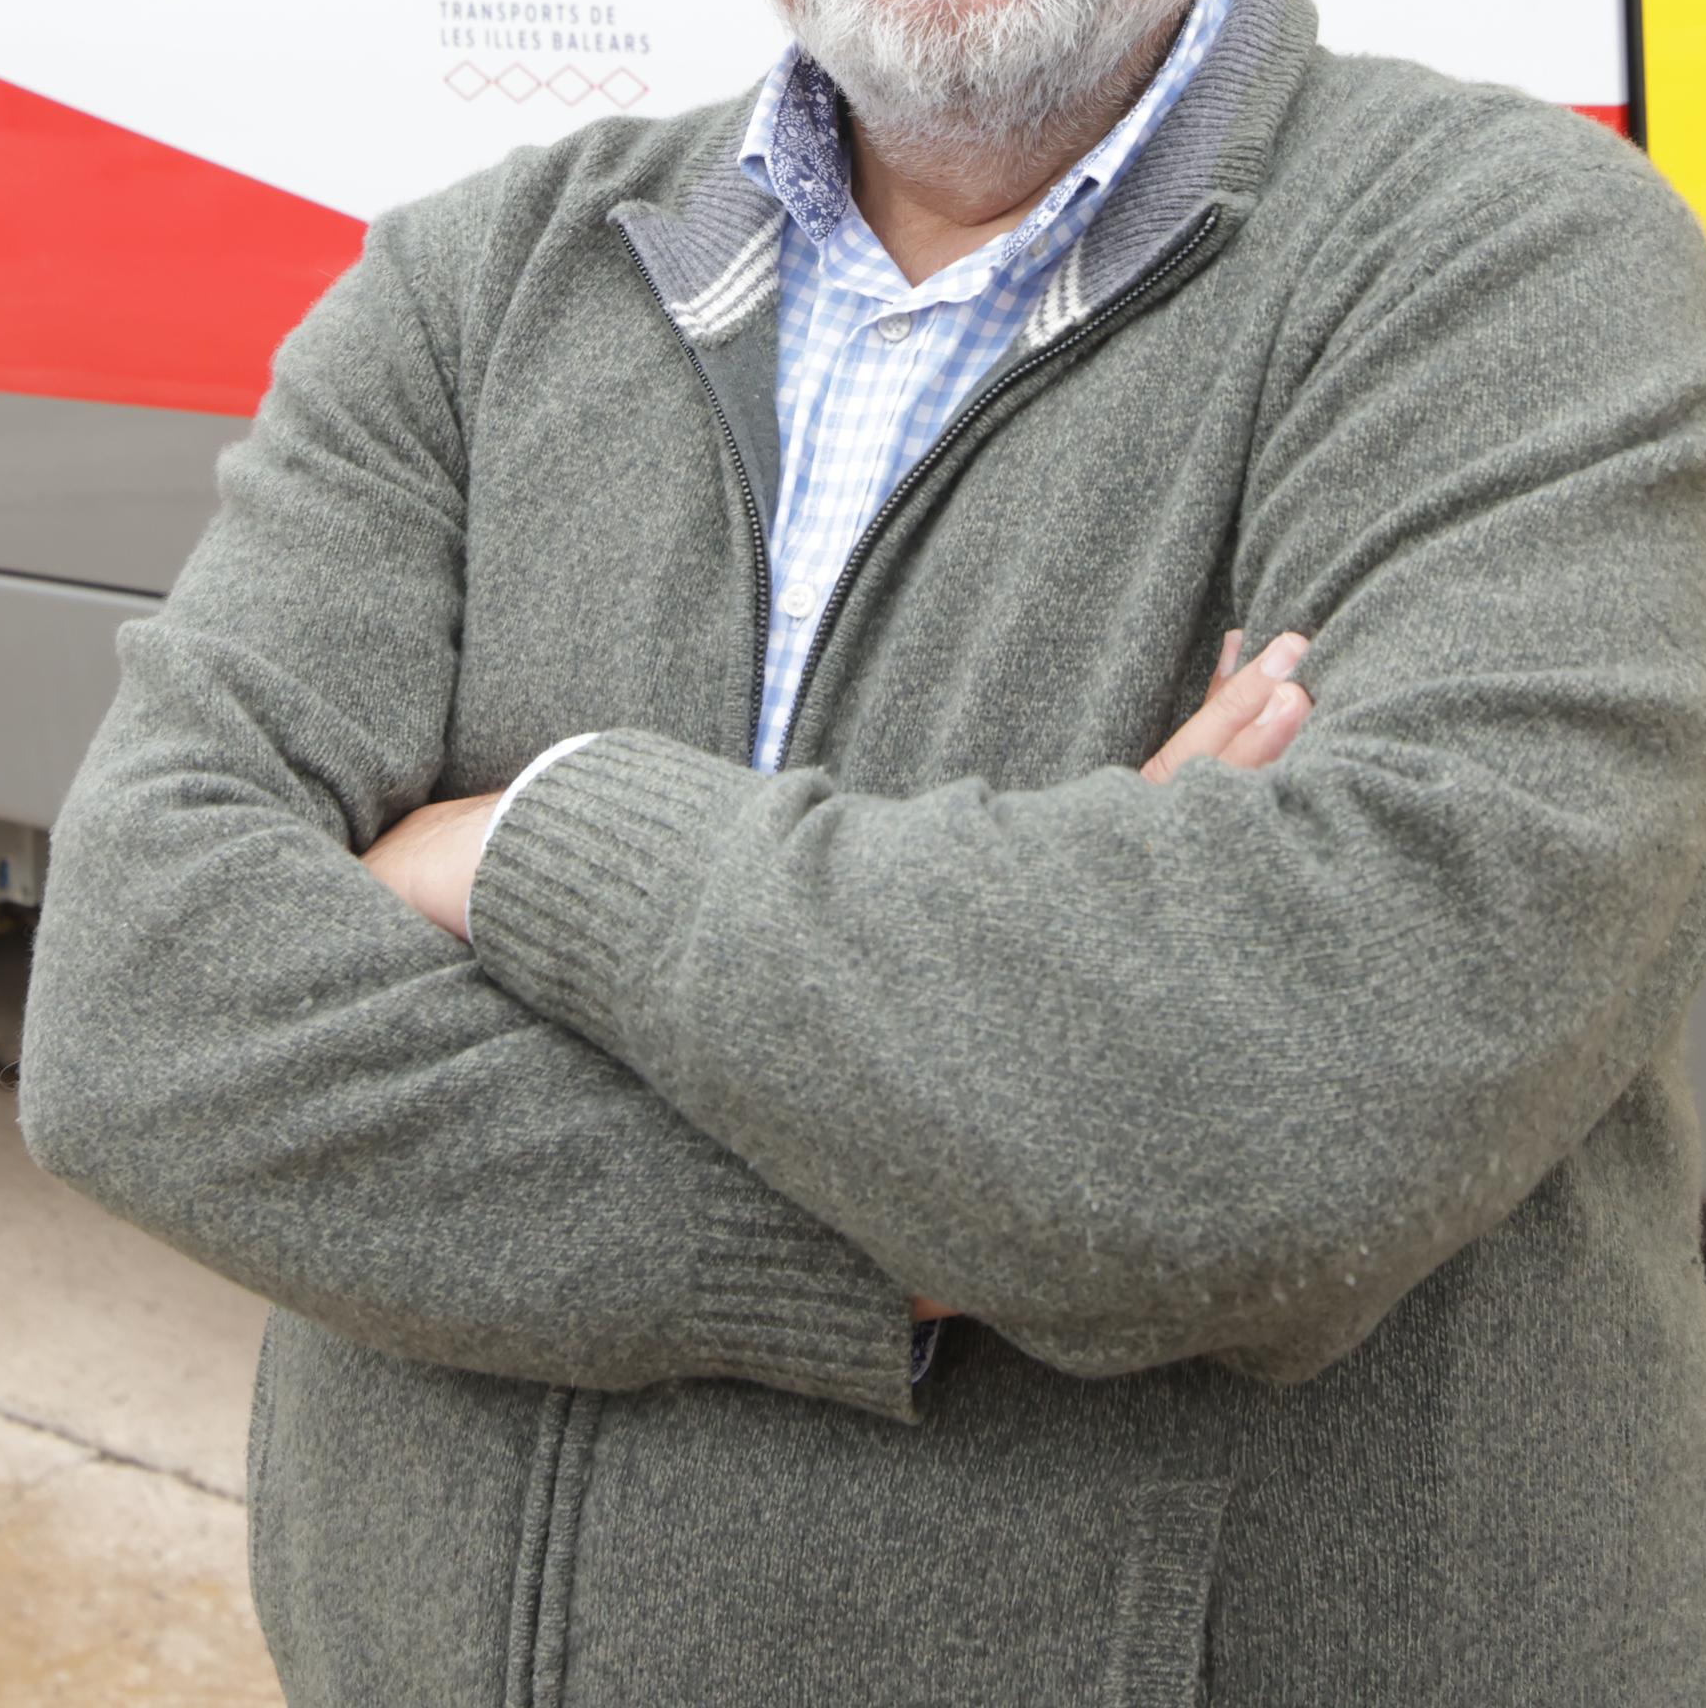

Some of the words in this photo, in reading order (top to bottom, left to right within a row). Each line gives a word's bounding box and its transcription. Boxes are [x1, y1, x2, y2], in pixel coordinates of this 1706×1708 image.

[440, 1, 580, 24] TRANSPORTS
[590, 5, 616, 25] DE
[441, 29, 475, 48] LES
[485, 30, 542, 50] ILLES
[552, 32, 651, 54] BALEARS
